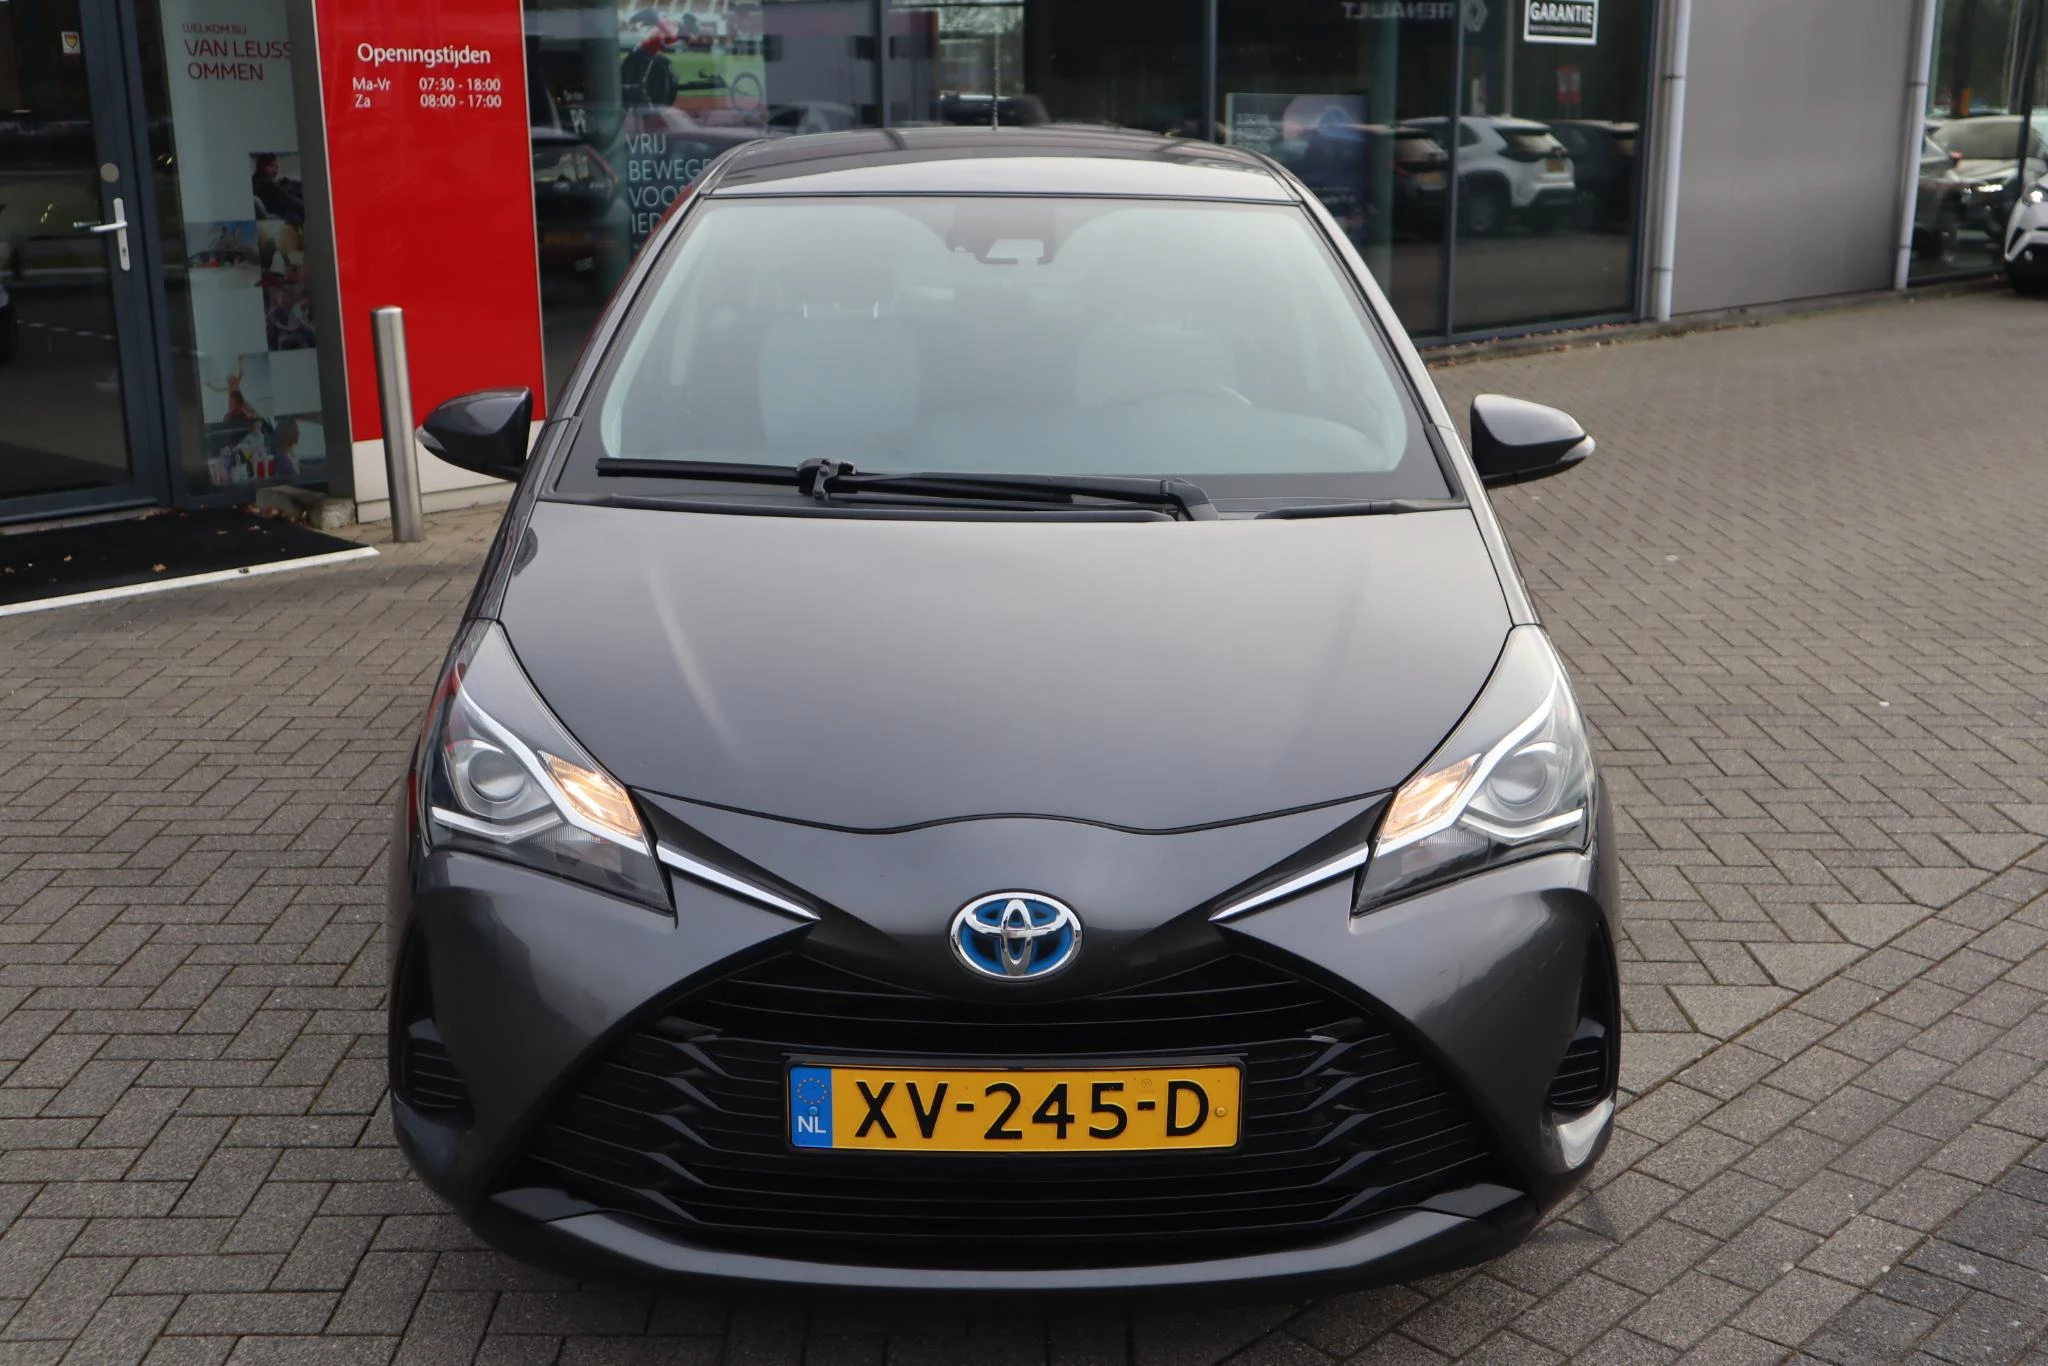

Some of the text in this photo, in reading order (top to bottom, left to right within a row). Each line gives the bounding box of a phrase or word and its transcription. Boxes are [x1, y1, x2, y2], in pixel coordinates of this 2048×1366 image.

[1530, 1, 1594, 24] GARANTIE
[184, 39, 228, 57] VAN
[357, 42, 492, 69] Openingstijden
[187, 62, 264, 81] OMMEN
[352, 77, 391, 92] Ma-Vr
[418, 77, 455, 92] 07:30
[467, 77, 501, 92] 18:00
[355, 94, 371, 109] Za
[420, 94, 456, 109] 08:00
[468, 94, 502, 109] 17:00
[624, 133, 667, 154] VRIJ
[627, 184, 686, 208] VOO
[854, 1079, 1210, 1140] XV-245-D
[797, 1115, 827, 1134] NL
